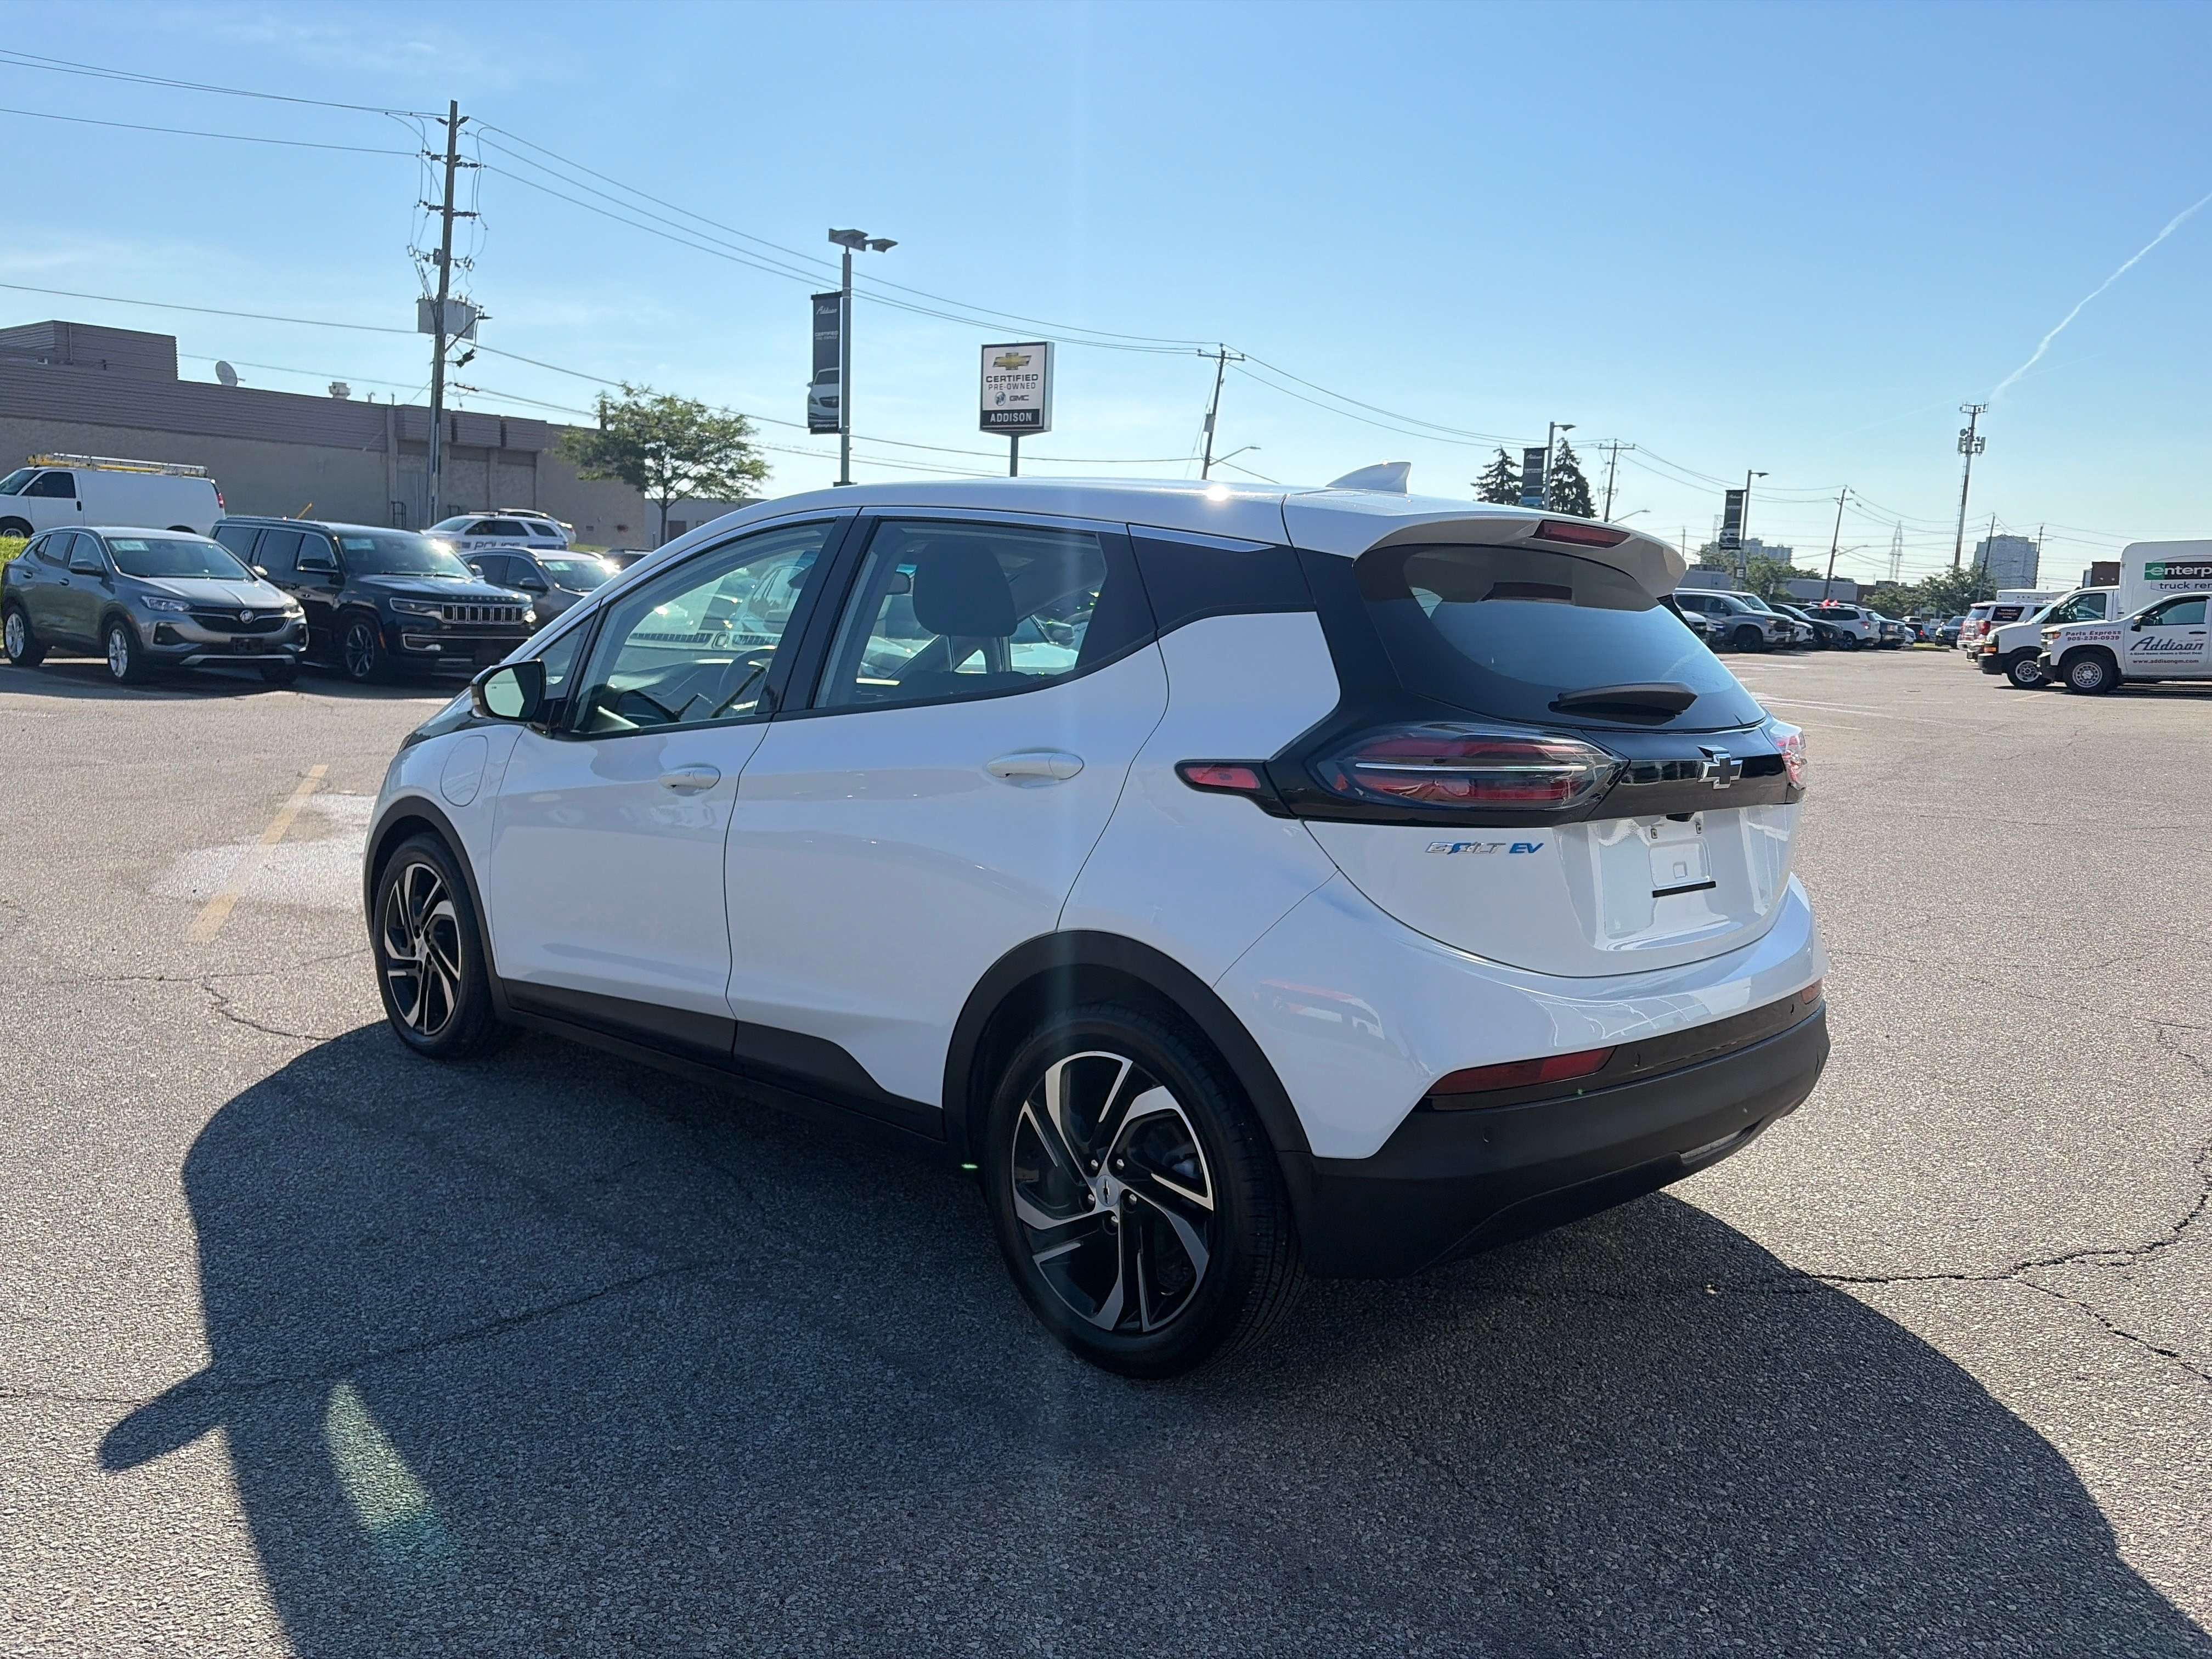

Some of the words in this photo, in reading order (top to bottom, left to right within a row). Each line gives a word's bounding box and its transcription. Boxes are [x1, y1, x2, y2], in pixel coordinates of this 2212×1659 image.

[986, 374, 1039, 383] CERTIFIED
[988, 382, 1036, 391] PRE-OWNED
[990, 413, 1032, 422] ADDISON
[2130, 636, 2204, 651] Addison
[1425, 842, 1506, 855] BOLT
[1509, 842, 1544, 854] EV
